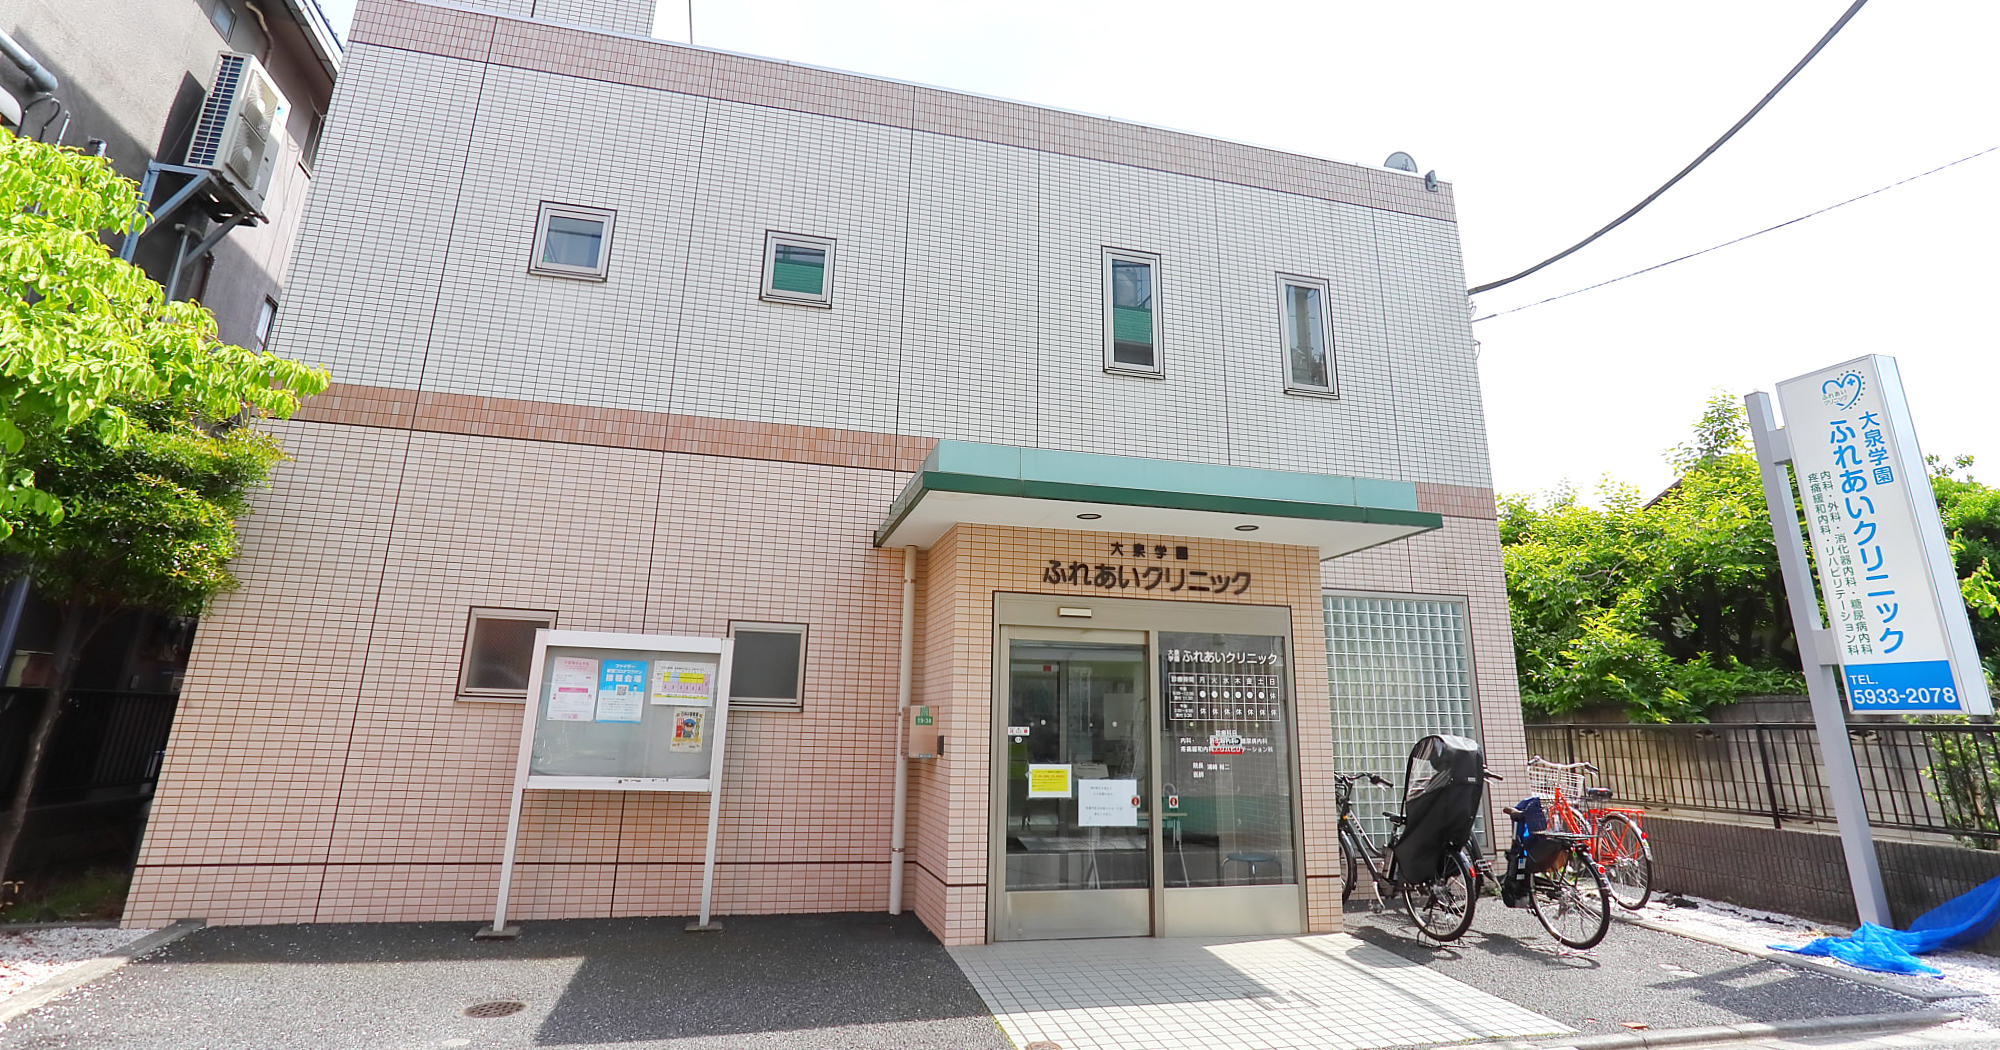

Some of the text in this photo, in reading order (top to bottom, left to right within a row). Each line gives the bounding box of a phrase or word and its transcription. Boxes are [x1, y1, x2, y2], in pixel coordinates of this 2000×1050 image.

[1822, 389, 1847, 400] ふれあい
[1824, 395, 1848, 406] クリニック
[1859, 411, 1895, 485] 大泉学園
[1829, 418, 1904, 654] ふれあいクリニック
[1110, 541, 1188, 560] 大泉学園
[1808, 473, 1859, 655] 疼痛緩和内科・リハビリテーション科
[1043, 560, 1251, 595] ふれあいクリニック
[1182, 650, 1277, 664] ふれあいクリニック
[1850, 675, 1878, 686] TEL.
[1853, 686, 1956, 705] 5933-2078
